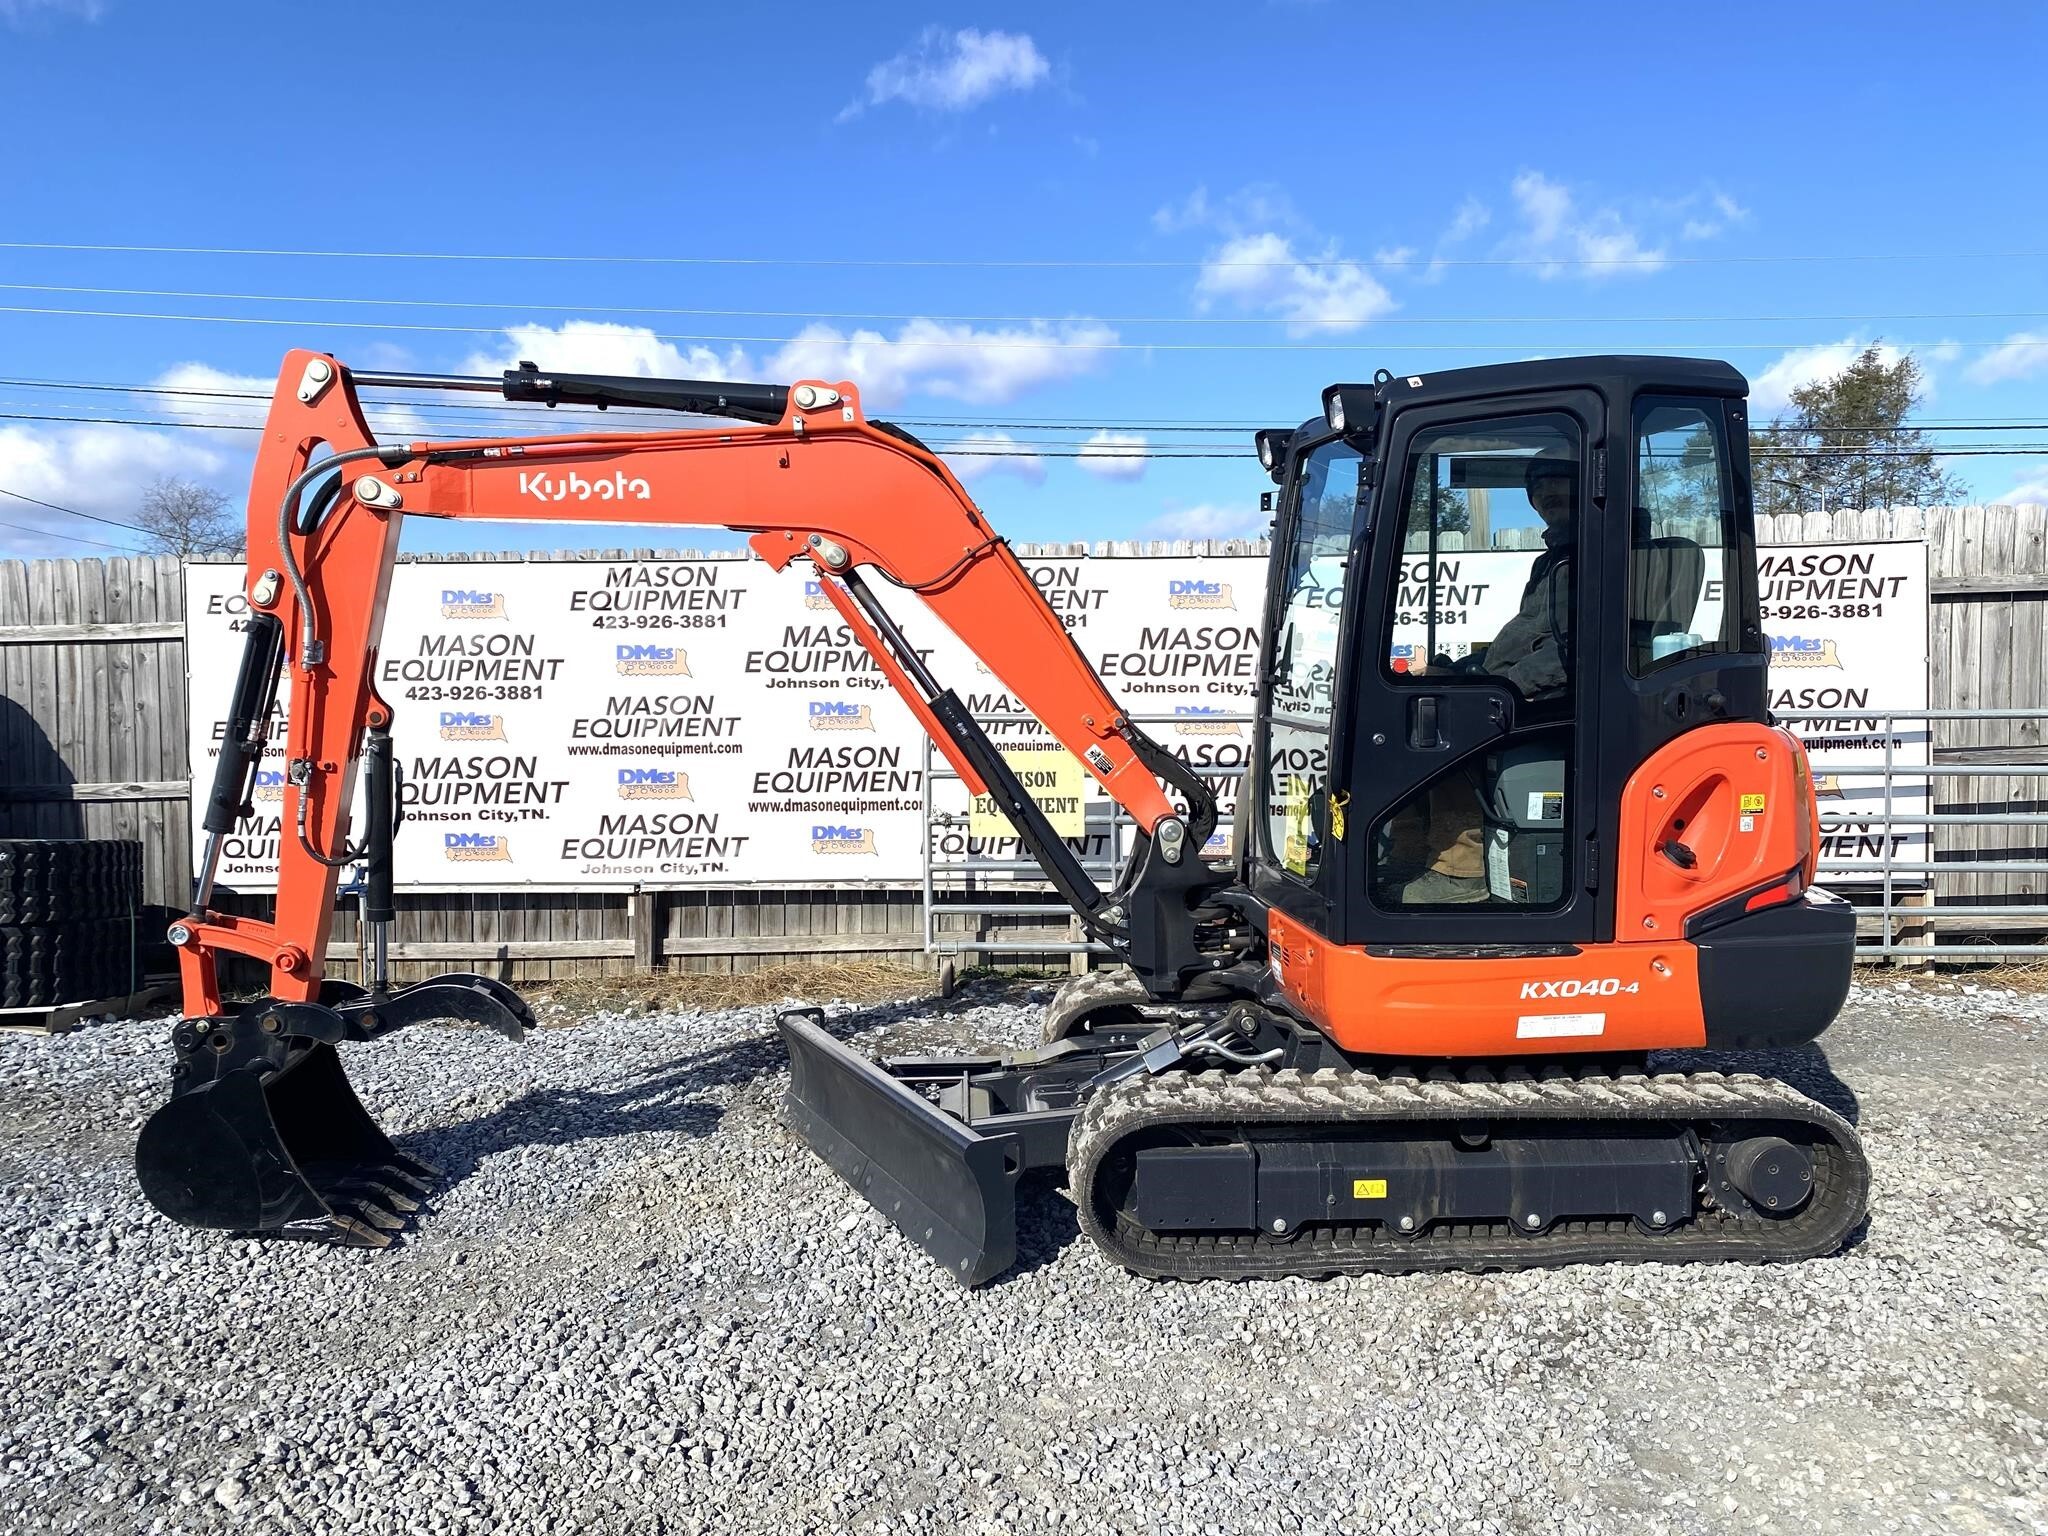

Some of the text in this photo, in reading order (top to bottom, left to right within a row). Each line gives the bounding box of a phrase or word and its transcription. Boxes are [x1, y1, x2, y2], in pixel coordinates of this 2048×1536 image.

[519, 471, 651, 501] Kubota
[605, 566, 718, 588] MASON
[1399, 561, 1460, 583] SON
[569, 588, 747, 611] EQUIPMENT
[1759, 576, 1908, 601] UIPMENT
[592, 614, 727, 629] 423-926-3881
[1760, 603, 1883, 619] 3-926-3881
[419, 634, 535, 656] MASON
[383, 659, 565, 682] EQUIPMENT
[1099, 653, 1256, 677] EQUIPME
[405, 685, 543, 701] 423-926-3881
[765, 677, 840, 689] Johnson
[1121, 682, 1200, 693] Johnson
[605, 695, 714, 715] MASON
[1768, 688, 1868, 709] ASON
[571, 717, 741, 738] EQUIPMENT
[568, 742, 743, 757] www.dmasonequipment.com
[787, 746, 900, 769] MASON
[412, 756, 538, 780] MASON
[401, 781, 570, 805] QUIPMENT
[478, 809, 550, 823] City,TN.
[599, 813, 719, 835] MASON
[561, 836, 749, 860] EQUIPMENT
[580, 862, 729, 875] Johnson City,TN.
[1520, 978, 1640, 1000] KX040-4
